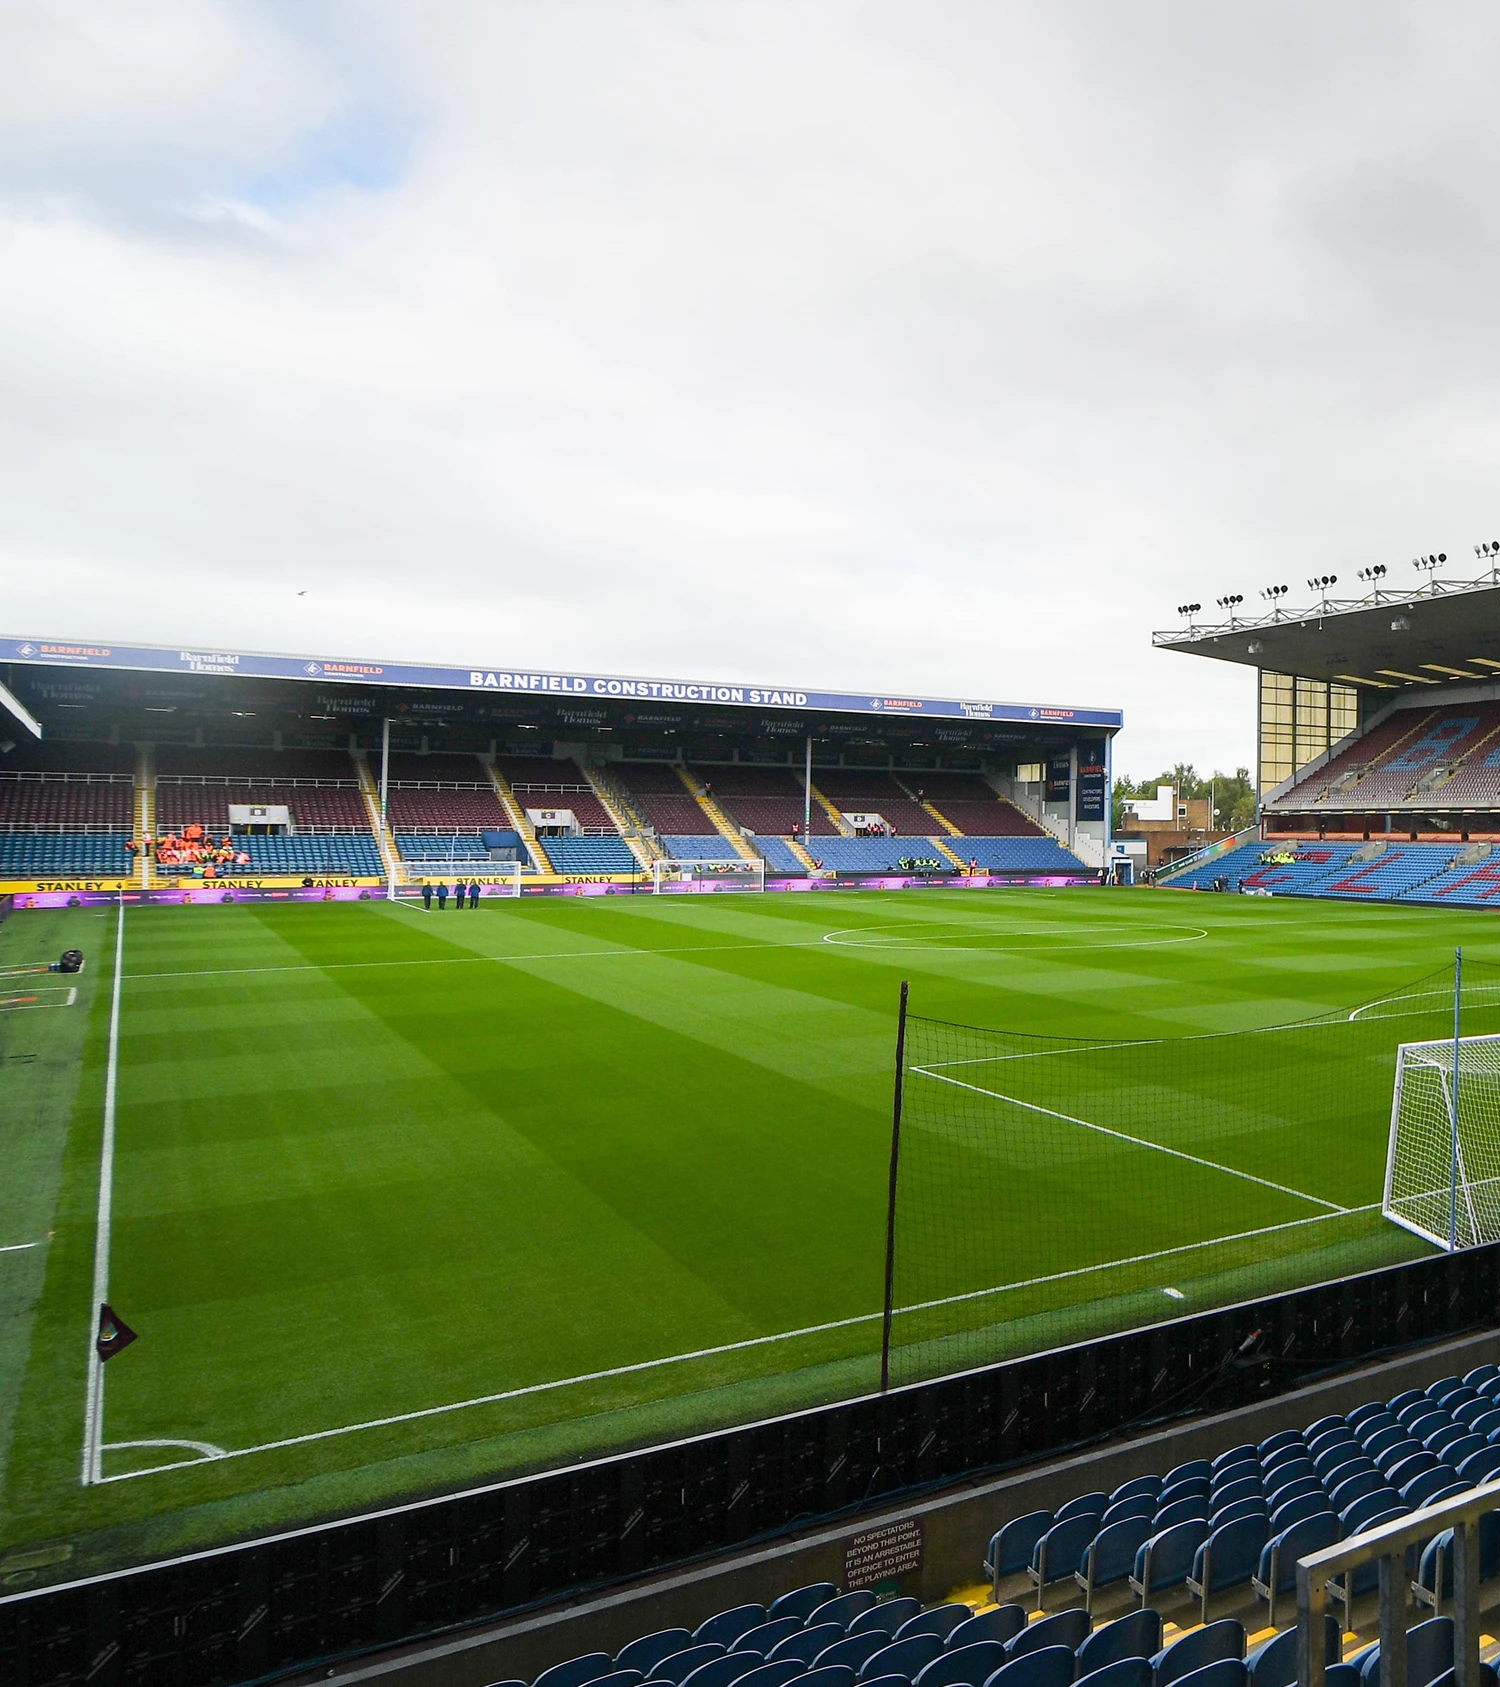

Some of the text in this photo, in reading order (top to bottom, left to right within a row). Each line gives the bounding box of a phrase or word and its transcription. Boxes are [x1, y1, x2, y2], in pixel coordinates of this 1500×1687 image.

[40, 645, 111, 656] BARNFIELD
[180, 651, 240, 664] Barnfield
[189, 662, 235, 672] Homes
[324, 664, 383, 674] BARNFIELD
[470, 672, 808, 706] BARNFIELD CONSTRUCTION STAND
[412, 703, 464, 712] BARNFIELD
[884, 700, 922, 708] BARNFIELD
[960, 702, 993, 712] Barnfield
[638, 714, 682, 722] BARNFIELD
[965, 708, 992, 718] Homes
[1040, 710, 1074, 718] BARNFIELD
[202, 880, 263, 890] STANLEY
[311, 879, 358, 888] TANLEY
[565, 876, 612, 884] STANLEY
[36, 882, 104, 892] STANLEY
[854, 1521, 914, 1546] NO SPECTATORS
[846, 1530, 920, 1558] BEYOND THIS POINT.
[846, 1539, 922, 1568] IT IS AN ARRESTABLE
[848, 1550, 920, 1578] OFFENCE TO ENTER
[848, 1578, 864, 1588] THE
[864, 1567, 896, 1584] PLAYING
